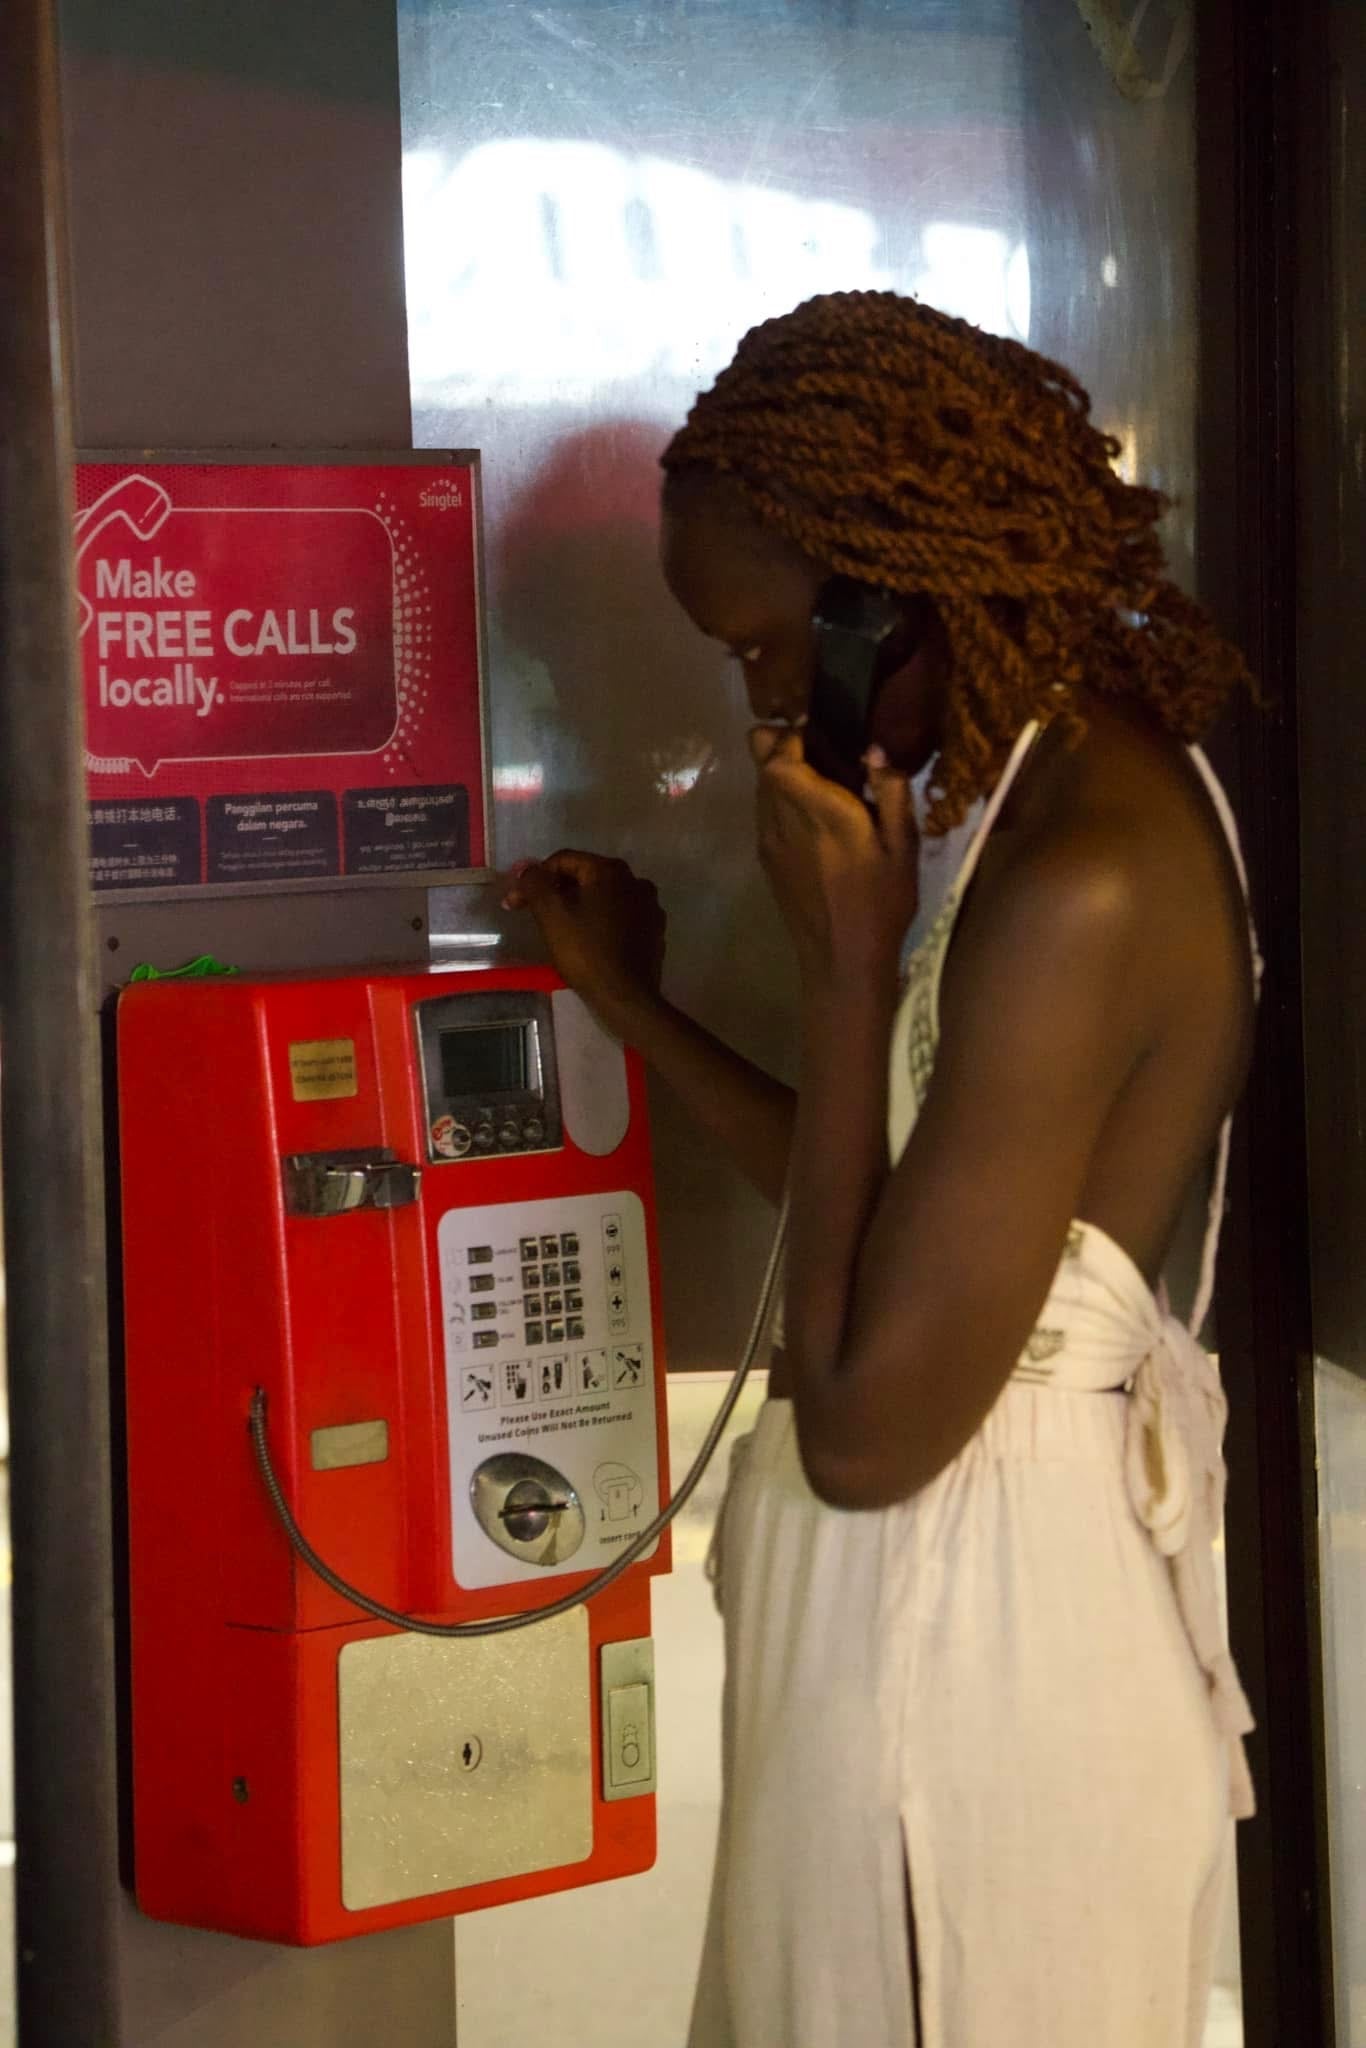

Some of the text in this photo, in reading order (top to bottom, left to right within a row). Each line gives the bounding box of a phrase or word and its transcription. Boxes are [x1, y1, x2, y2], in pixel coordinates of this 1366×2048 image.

[419, 491, 462, 511] Singtel
[96, 556, 196, 599] Make
[98, 607, 358, 659] FREE CALLS
[98, 663, 225, 717] locally.
[275, 801, 319, 816] percuma
[236, 818, 267, 832] dalam
[478, 1411, 633, 1443] Unused Coins Will Not Be Returned
[500, 1402, 611, 1425] Please Use Exact Amount
